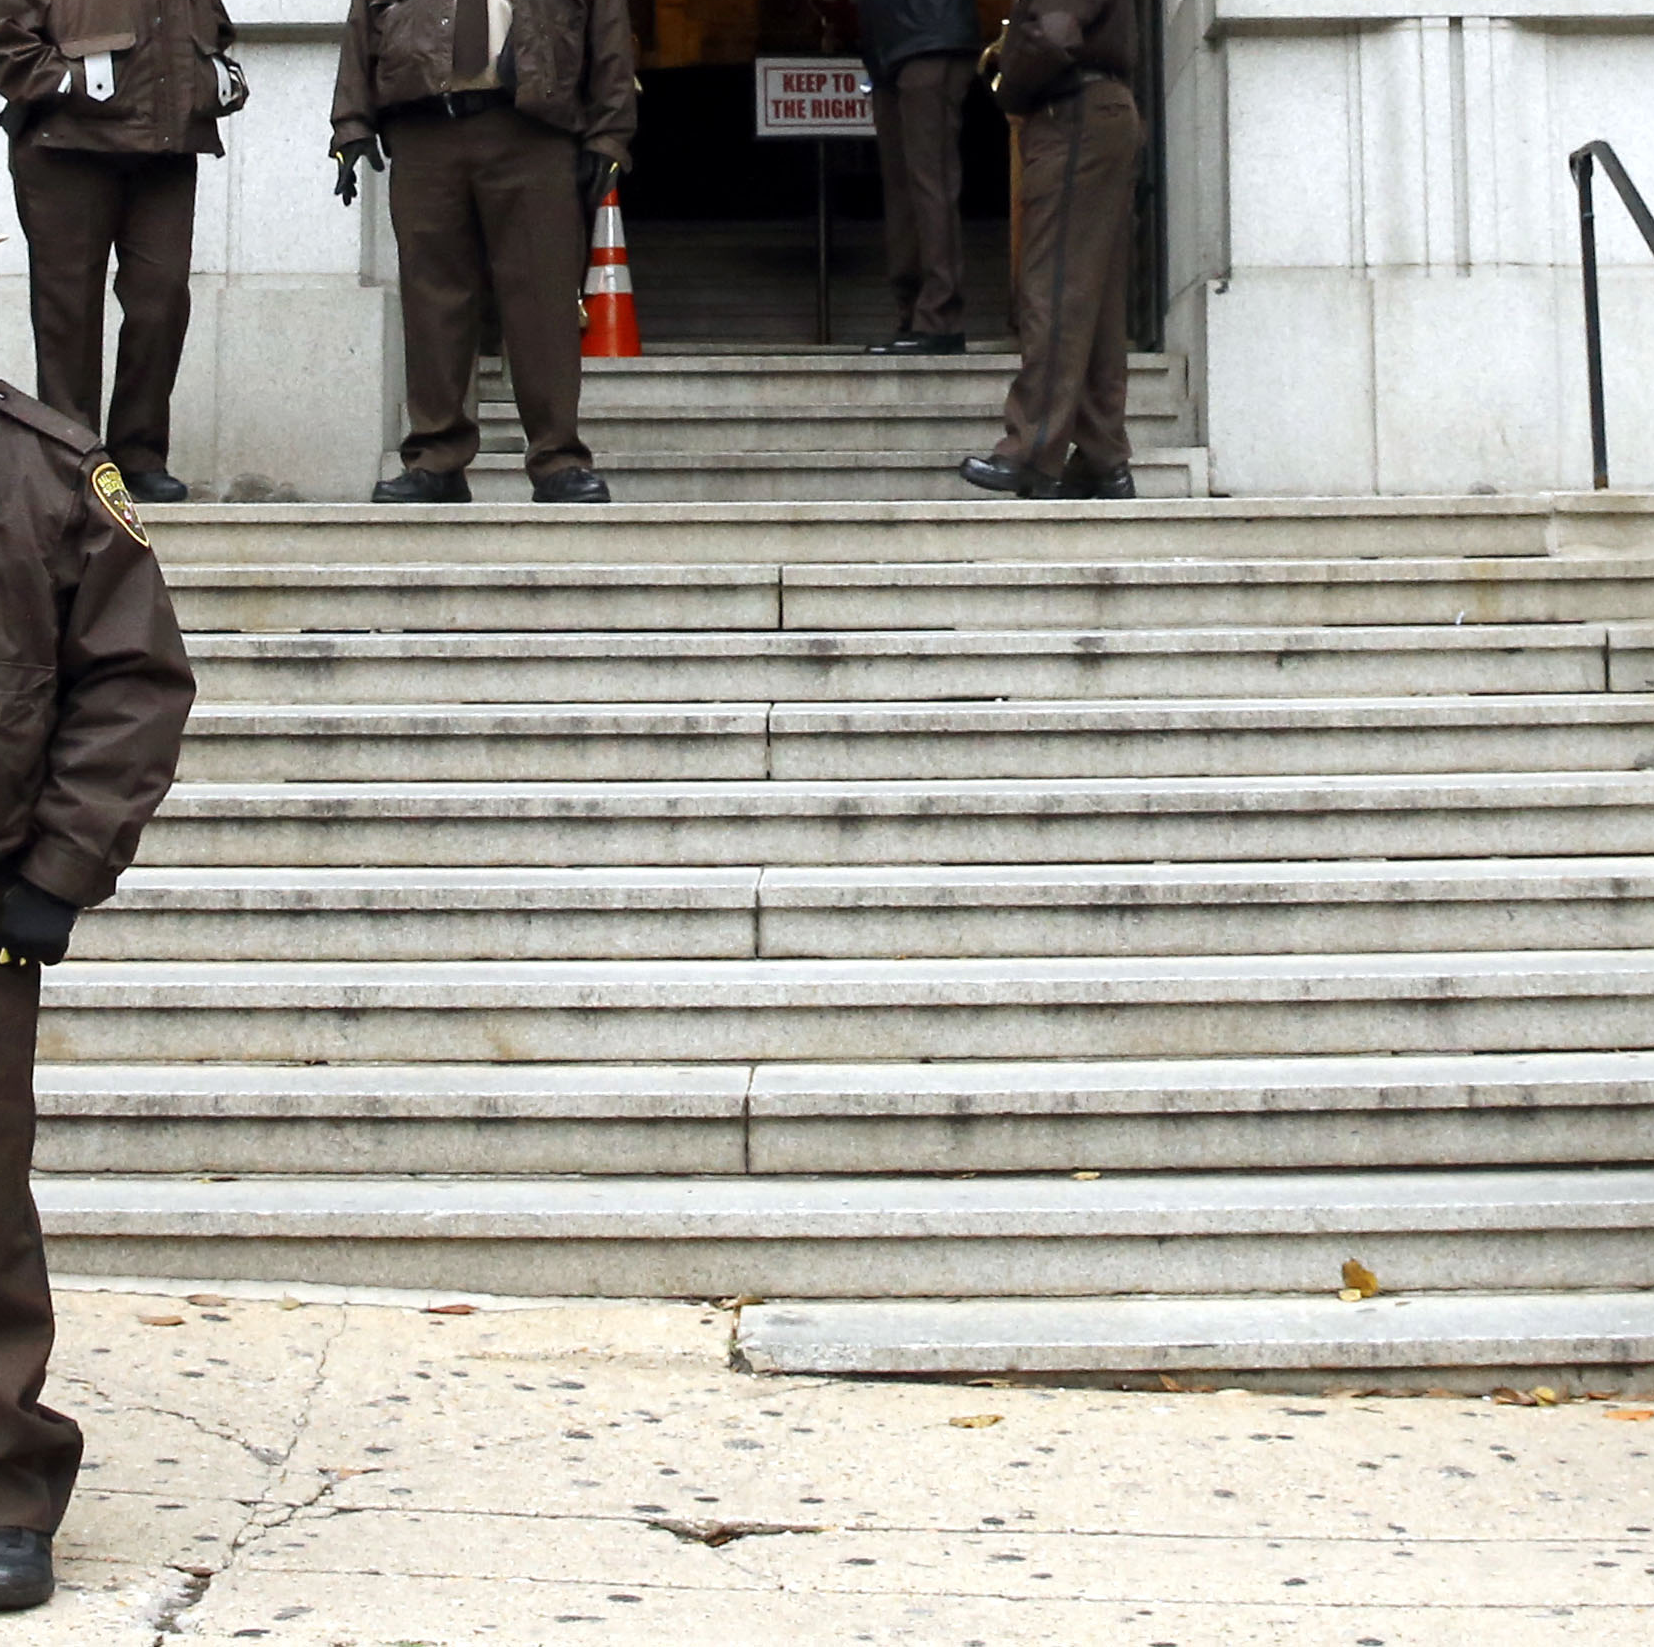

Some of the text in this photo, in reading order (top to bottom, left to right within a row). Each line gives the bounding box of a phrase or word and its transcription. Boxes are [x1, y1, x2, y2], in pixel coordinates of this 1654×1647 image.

[782, 72, 856, 94] KEEP TO
[771, 98, 867, 120] THE RIGHT
